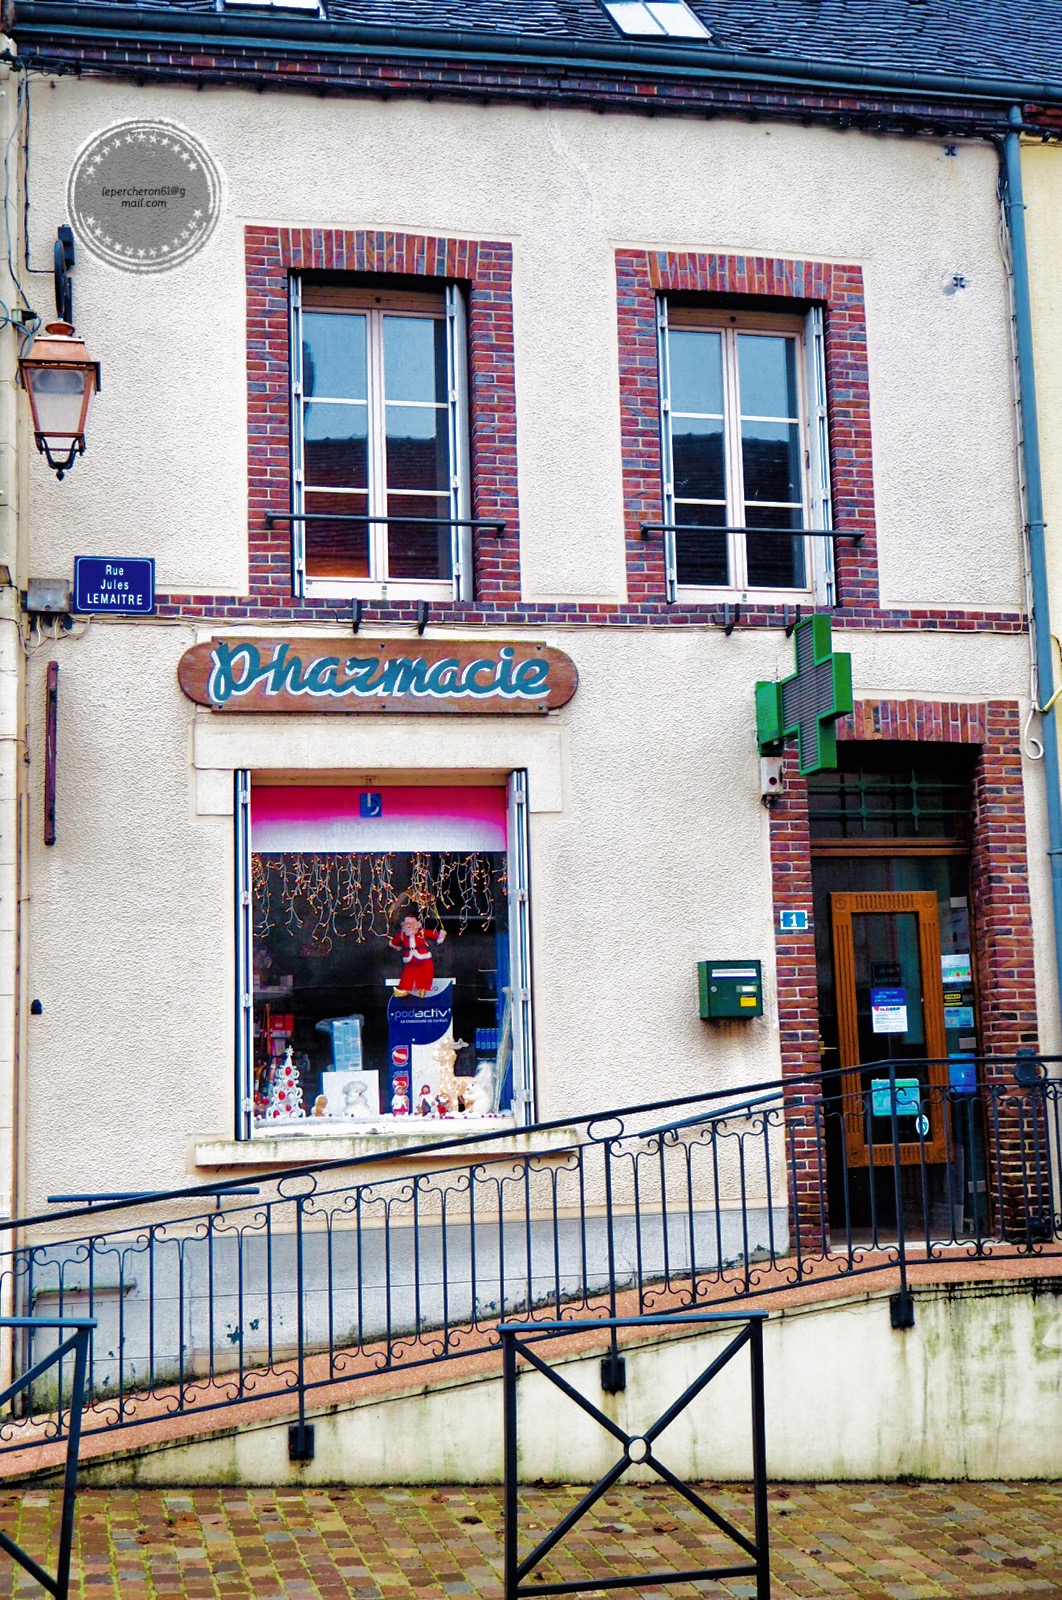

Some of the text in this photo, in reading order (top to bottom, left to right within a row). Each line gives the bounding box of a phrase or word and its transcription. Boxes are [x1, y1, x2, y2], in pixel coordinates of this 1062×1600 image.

[105, 564, 124, 576] Rue
[100, 578, 129, 590] Jules
[87, 593, 143, 605] LEMAITRE
[789, 913, 798, 927] 1
